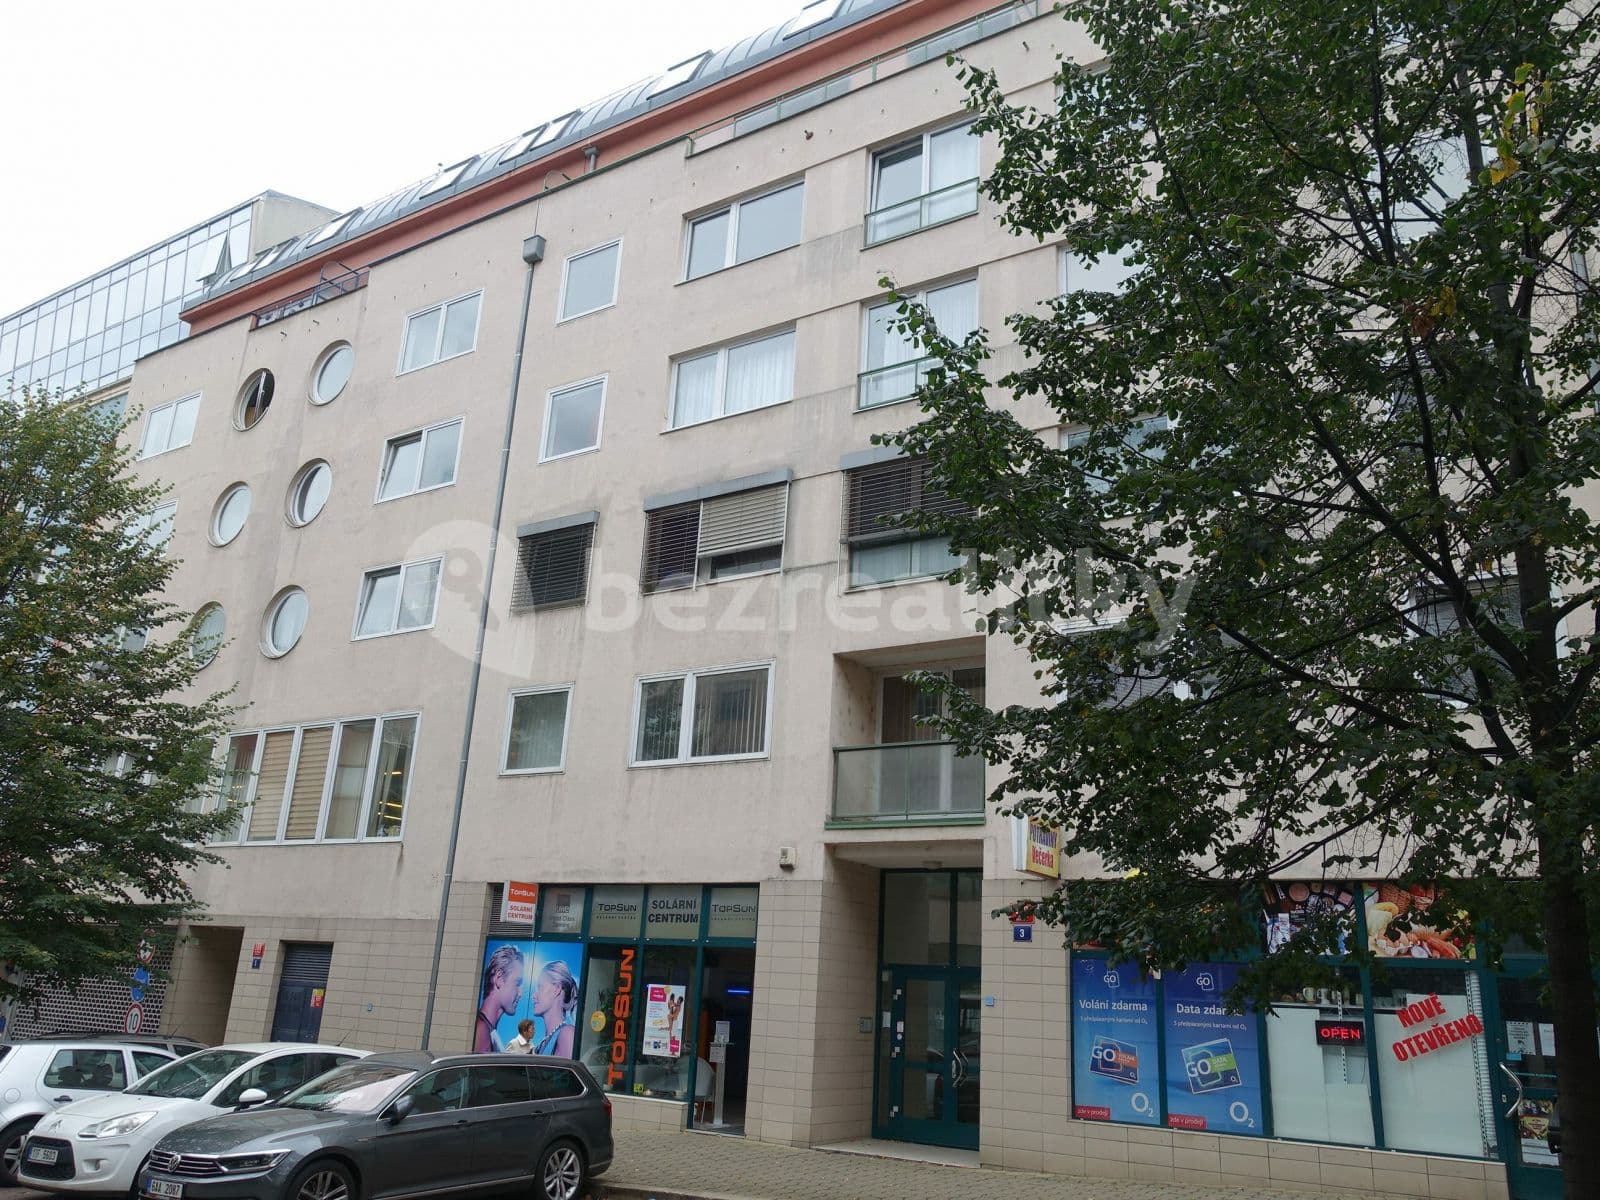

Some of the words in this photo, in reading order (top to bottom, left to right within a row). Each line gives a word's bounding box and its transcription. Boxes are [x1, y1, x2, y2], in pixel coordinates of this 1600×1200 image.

[651, 898, 697, 910] SOLÁRNÍ
[648, 913, 699, 923] CENTRUM
[1019, 928, 1025, 938] 3
[1103, 974, 1117, 984] GO
[1196, 976, 1211, 987] GO
[1079, 999, 1109, 1010] Volání
[1111, 1000, 1148, 1011] zdarma
[1176, 1003, 1200, 1014] Data
[129, 1013, 139, 1030] 10
[607, 949, 635, 1086] TOPSUN
[1320, 1027, 1361, 1040] OPEN
[1392, 1013, 1483, 1062] OTEVŘENO
[1091, 1046, 1116, 1062] GO
[1186, 1059, 1211, 1077] GO
